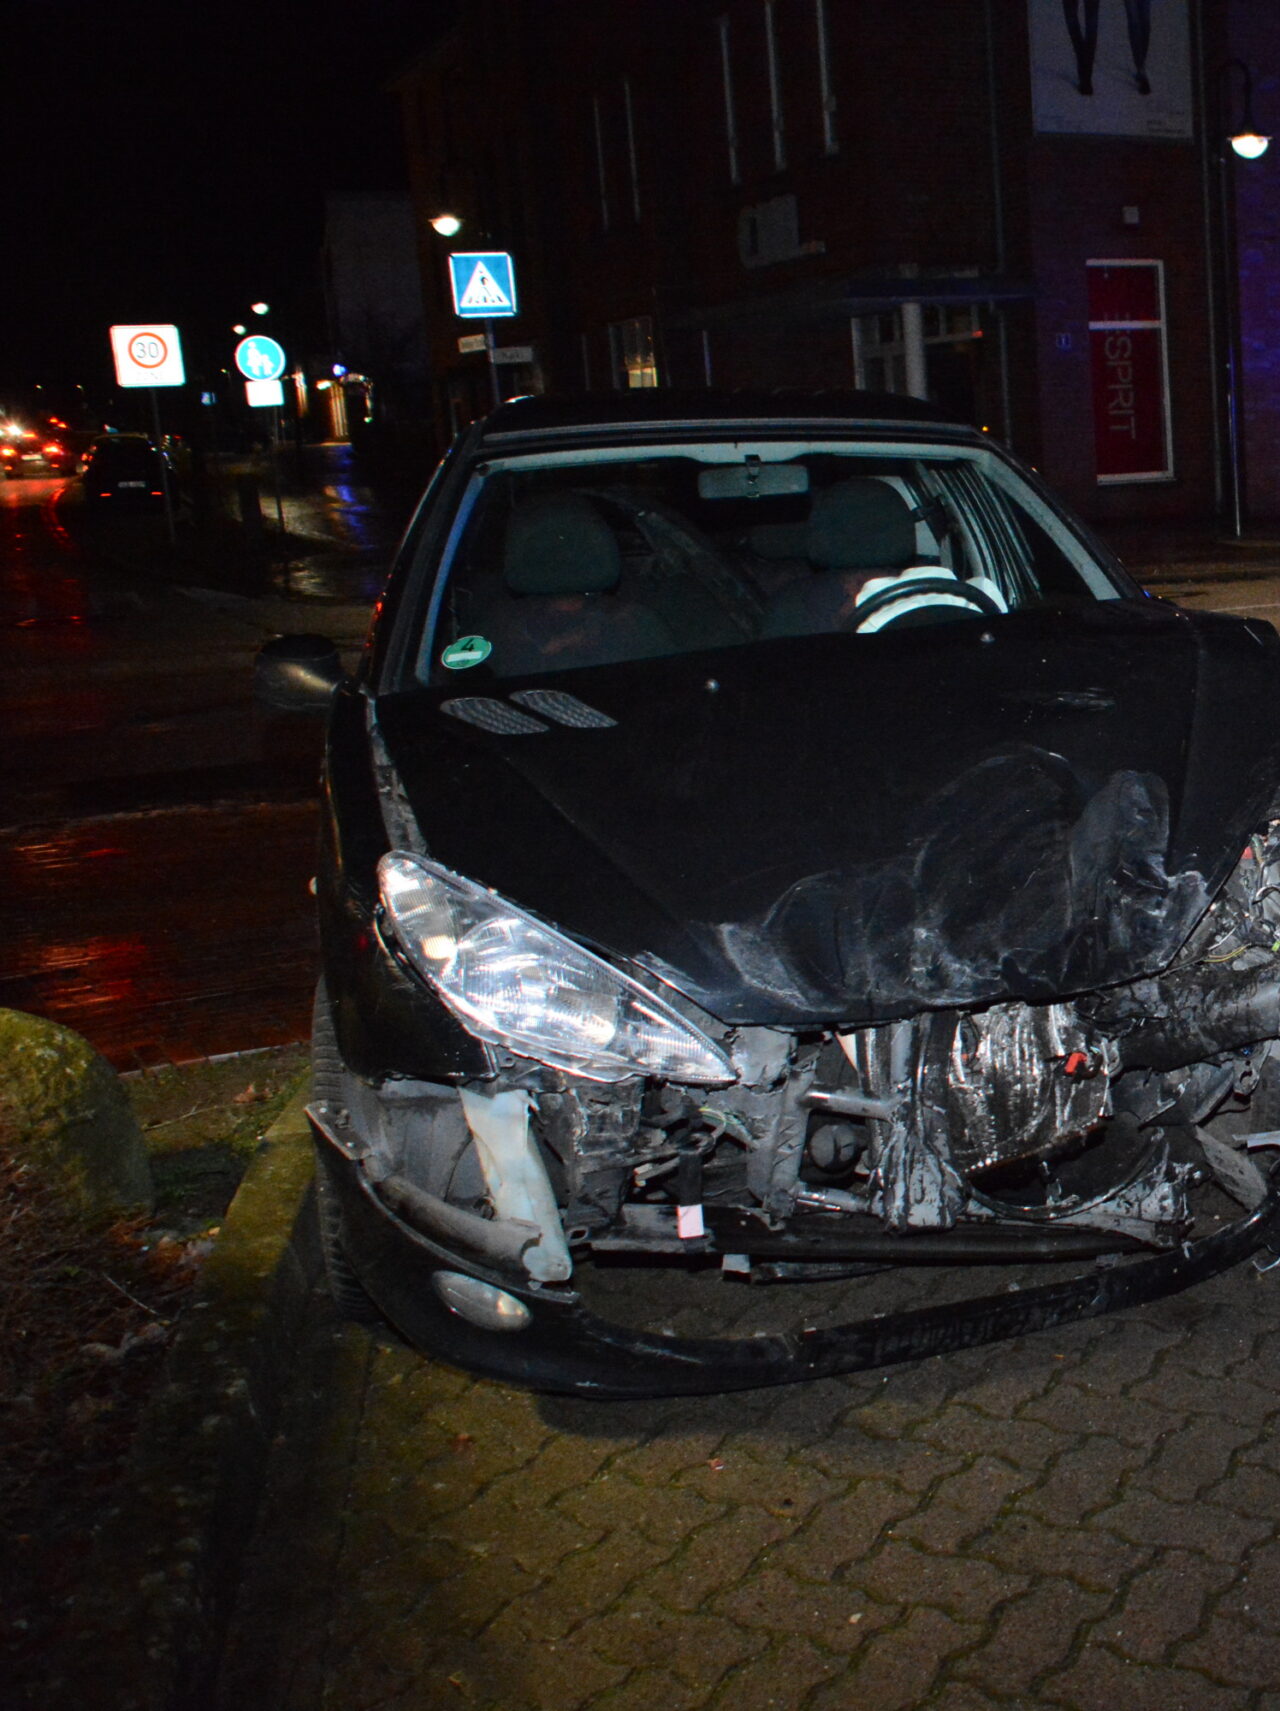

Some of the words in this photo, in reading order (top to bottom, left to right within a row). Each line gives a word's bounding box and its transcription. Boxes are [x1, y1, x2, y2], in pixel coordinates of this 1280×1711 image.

[136, 342, 159, 359] 30
[1103, 311, 1136, 440] ESPRIT
[460, 638, 475, 652] 4
